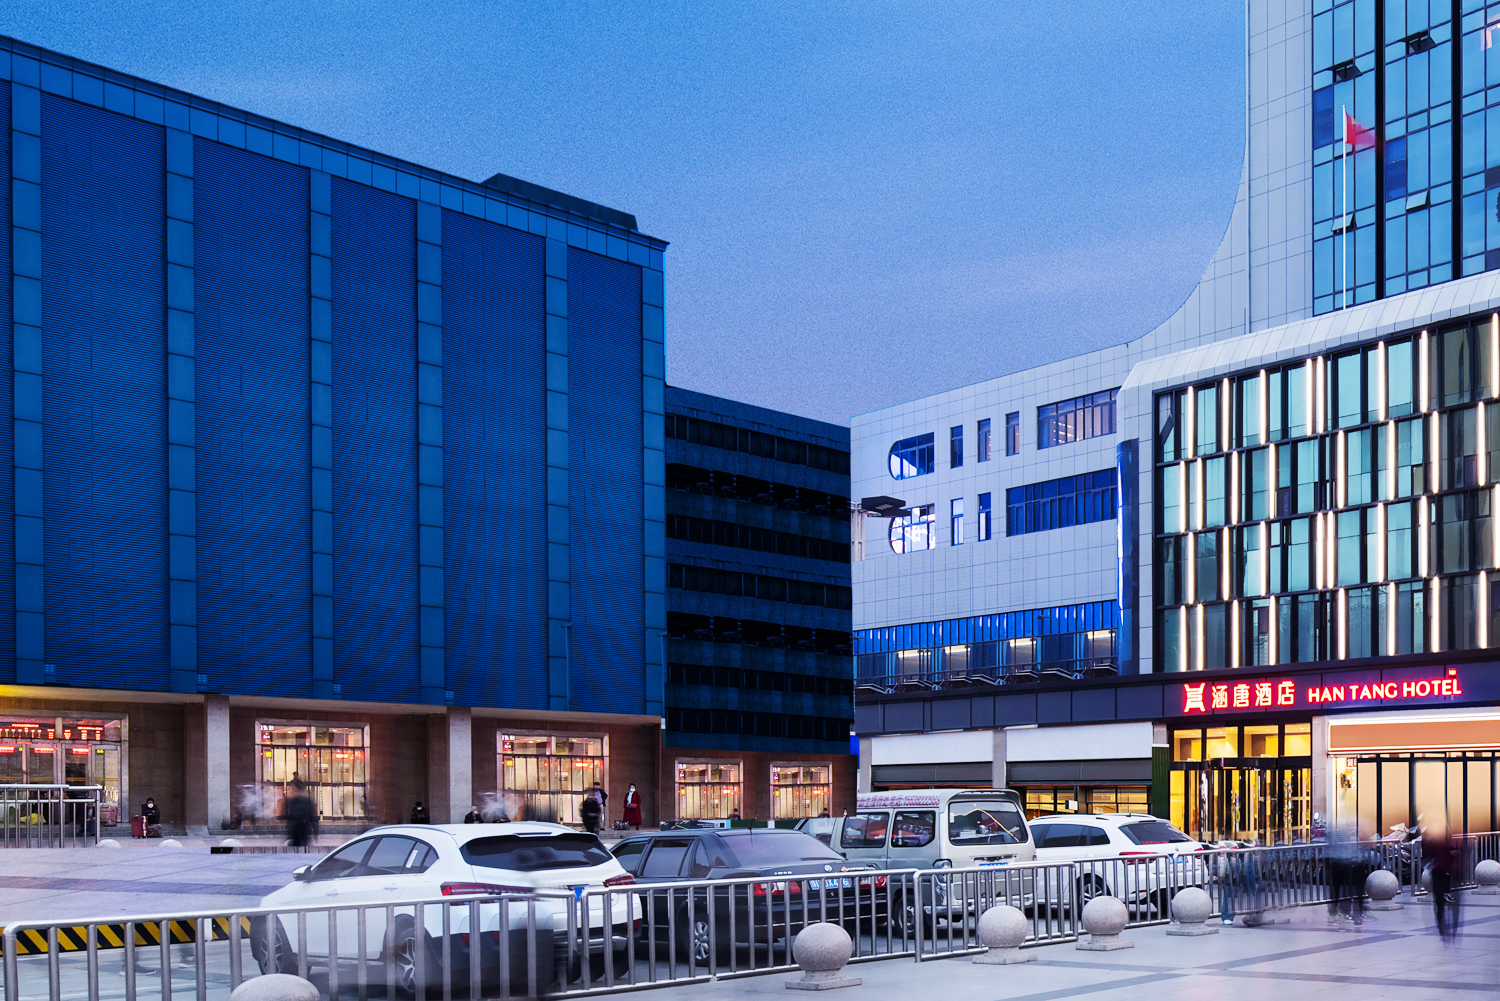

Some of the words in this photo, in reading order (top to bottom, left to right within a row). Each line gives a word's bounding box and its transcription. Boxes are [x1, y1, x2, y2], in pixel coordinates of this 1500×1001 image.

[1211, 680, 1295, 710] 涵唐酒店
[1308, 685, 1345, 703] HAN
[1349, 682, 1398, 700] TANG
[1402, 678, 1462, 698] HOTEL
